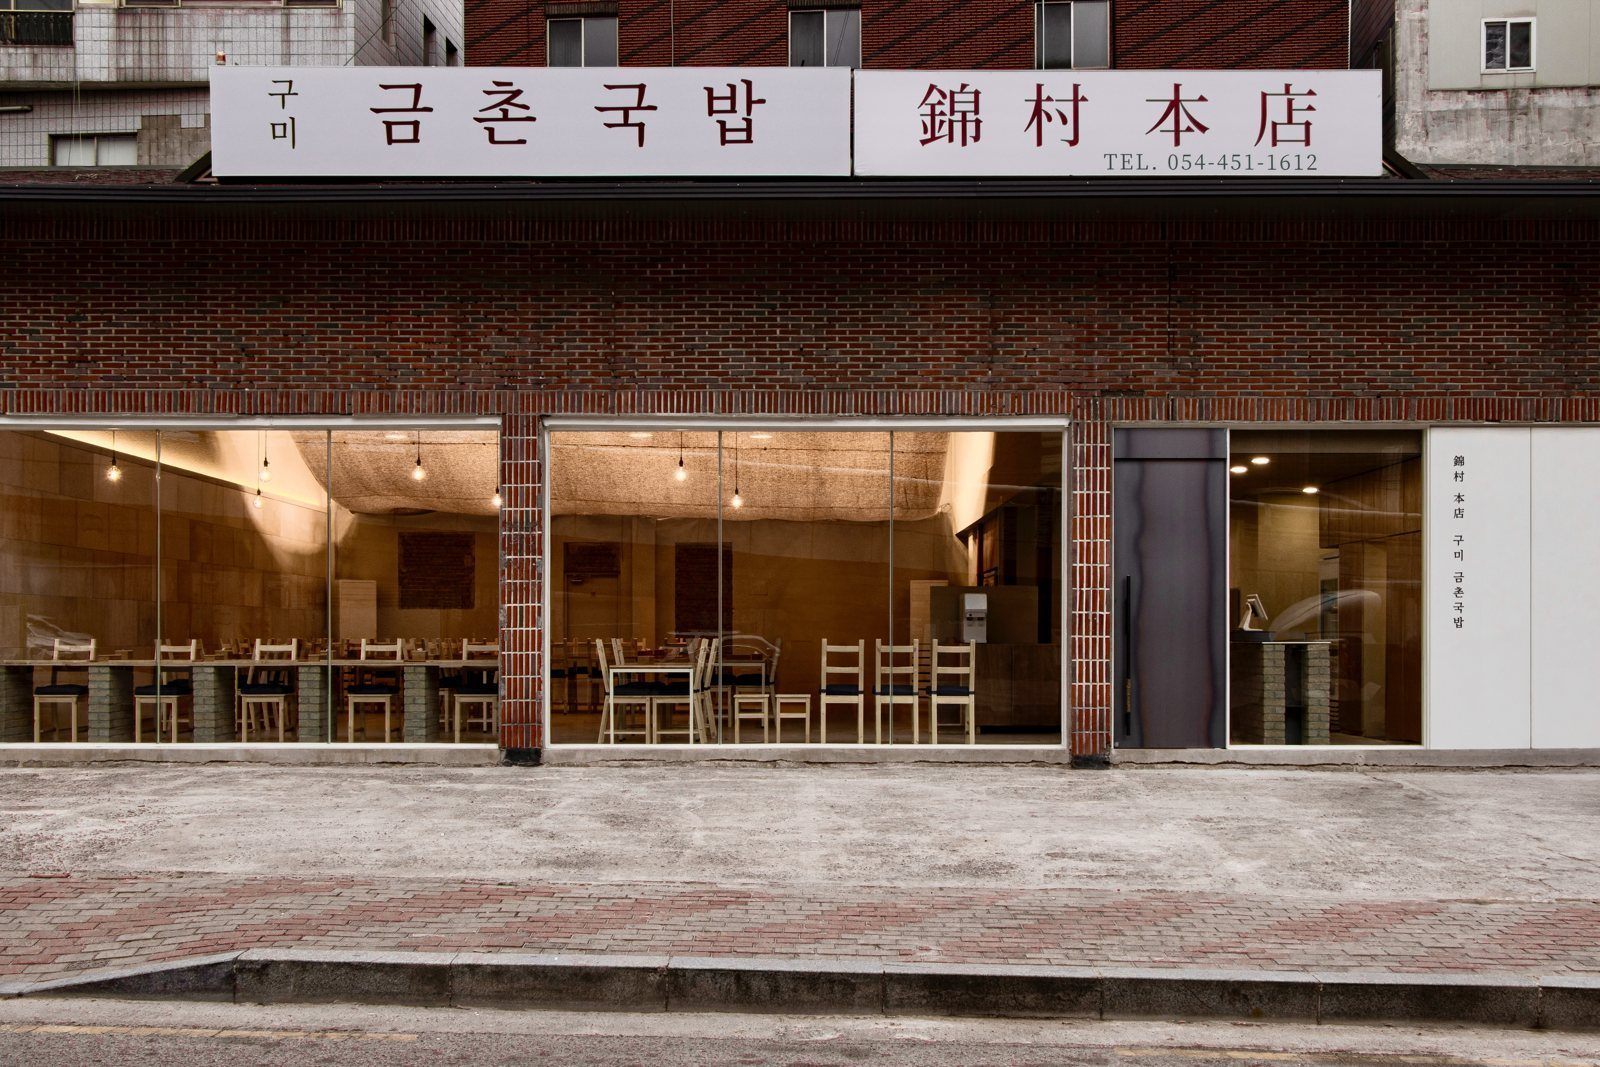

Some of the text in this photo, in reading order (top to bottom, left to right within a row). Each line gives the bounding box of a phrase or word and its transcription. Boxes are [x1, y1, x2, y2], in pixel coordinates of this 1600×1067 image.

[268, 79, 299, 150] 구미
[1104, 153, 1318, 171] TEL. 054-451-1612
[1453, 534, 1465, 562] 구미
[1453, 571, 1465, 629] 금촌국밥
